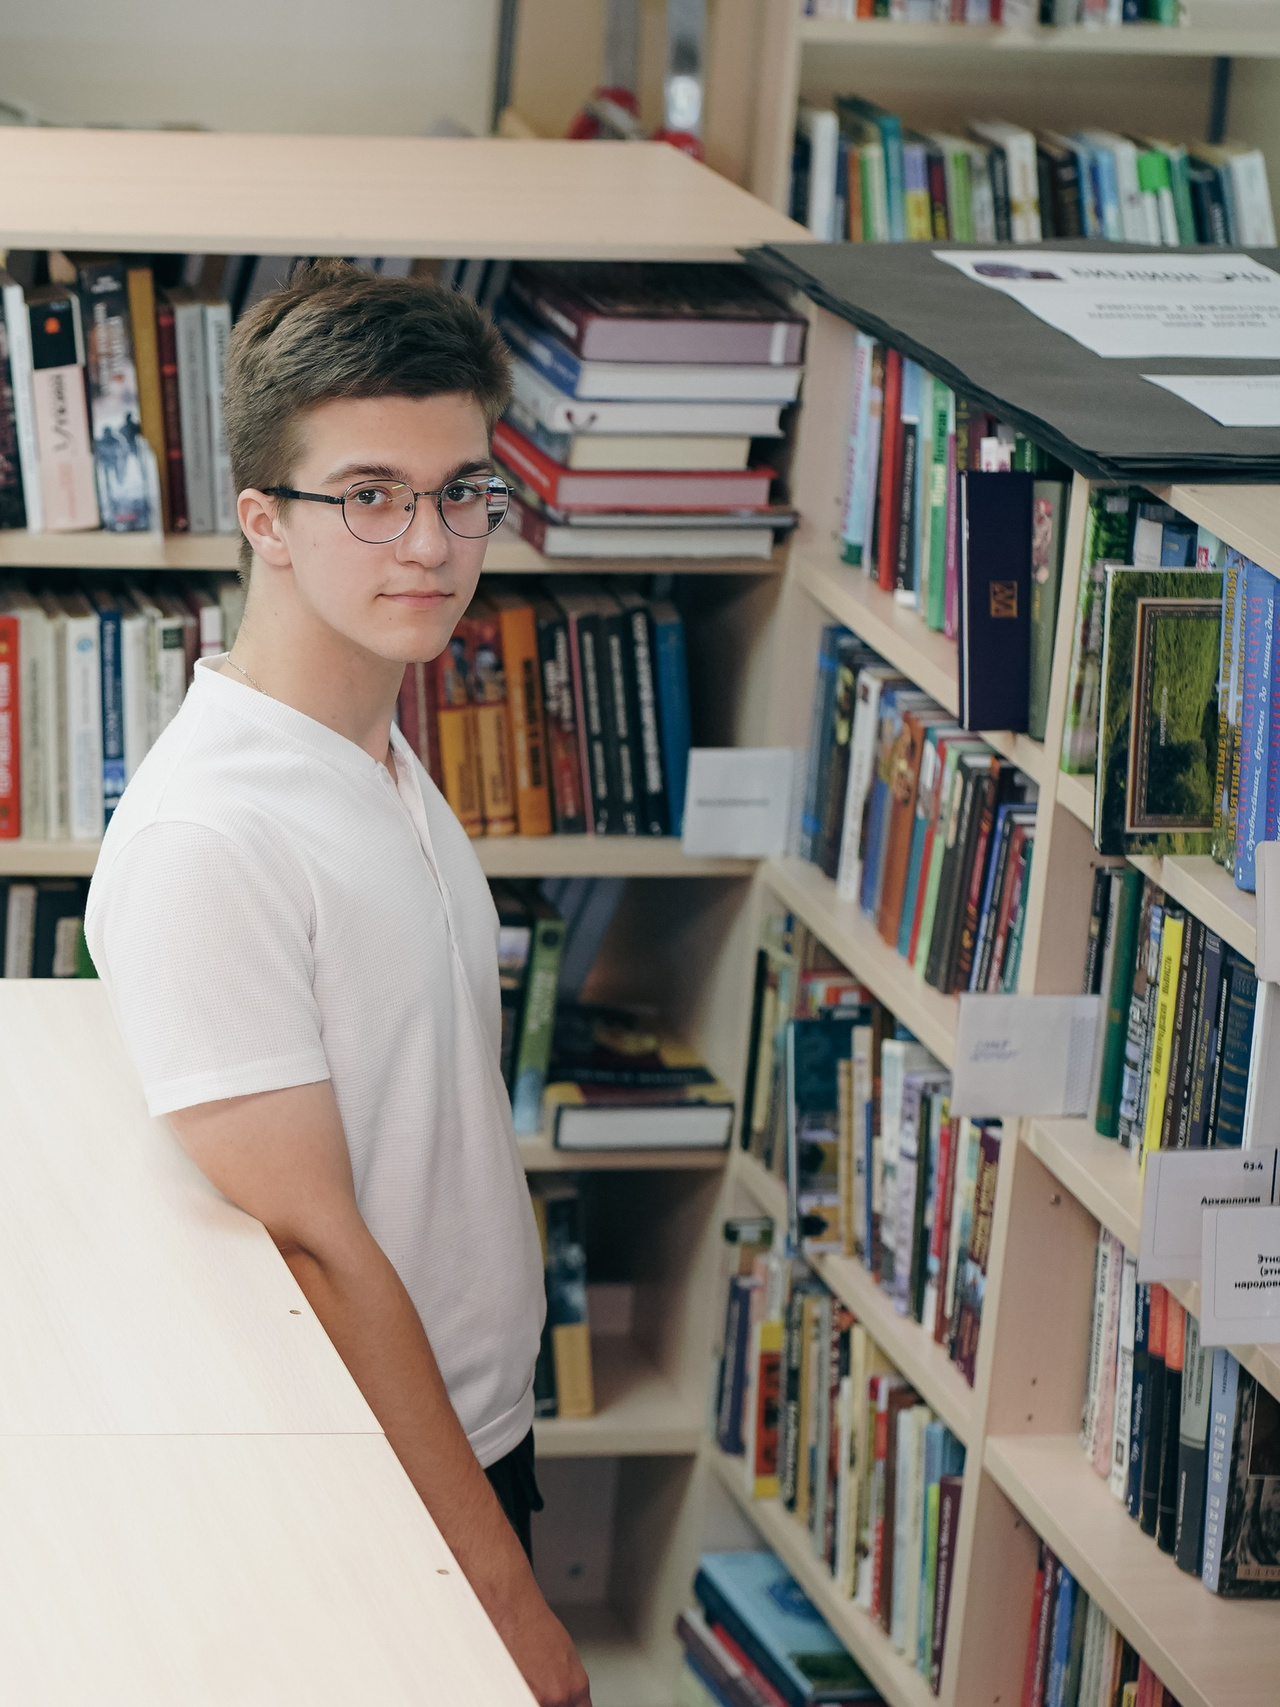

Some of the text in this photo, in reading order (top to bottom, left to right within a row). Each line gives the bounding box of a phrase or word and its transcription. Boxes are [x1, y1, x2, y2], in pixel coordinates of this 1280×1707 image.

[1248, 596, 1263, 665] КРАЙ
[1265, 598, 1274, 632] дней
[1263, 633, 1273, 679] наших
[1214, 568, 1238, 828] ПАМЯТНЫЕ МЕСТА ПОДМОСКОВЬЯ
[1259, 686, 1267, 703] до
[1254, 709, 1265, 761] времен
[1228, 751, 1242, 841] ПАМЯТНЫЕ
[1248, 766, 1262, 851] древнейших
[1211, 1411, 1227, 1484] БЕЛЫЙ
